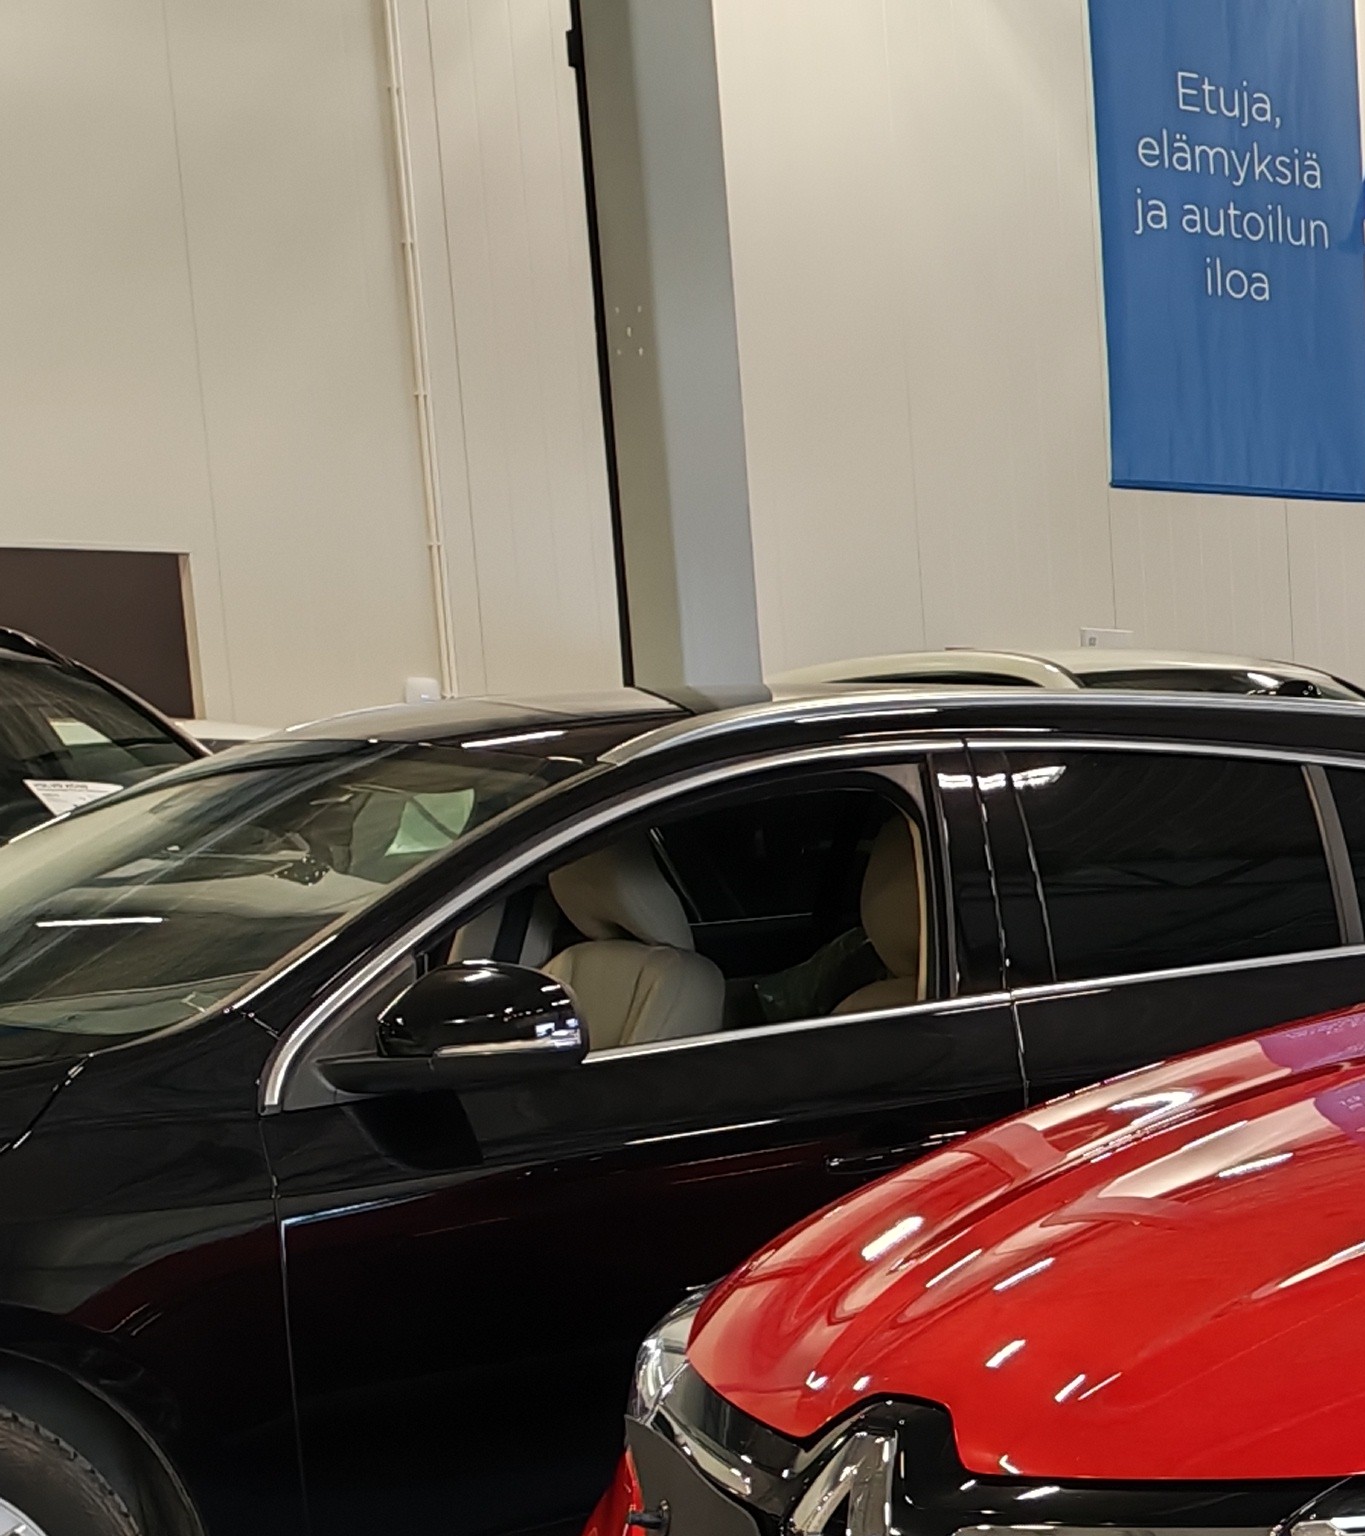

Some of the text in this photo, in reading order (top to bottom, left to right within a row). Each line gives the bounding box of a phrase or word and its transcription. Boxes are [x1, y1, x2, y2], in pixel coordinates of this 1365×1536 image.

[1177, 71, 1282, 129] Etuja,
[1137, 128, 1322, 189] elämyksiä
[1134, 187, 1329, 250] ja autoilun
[1206, 256, 1270, 301] iloa
